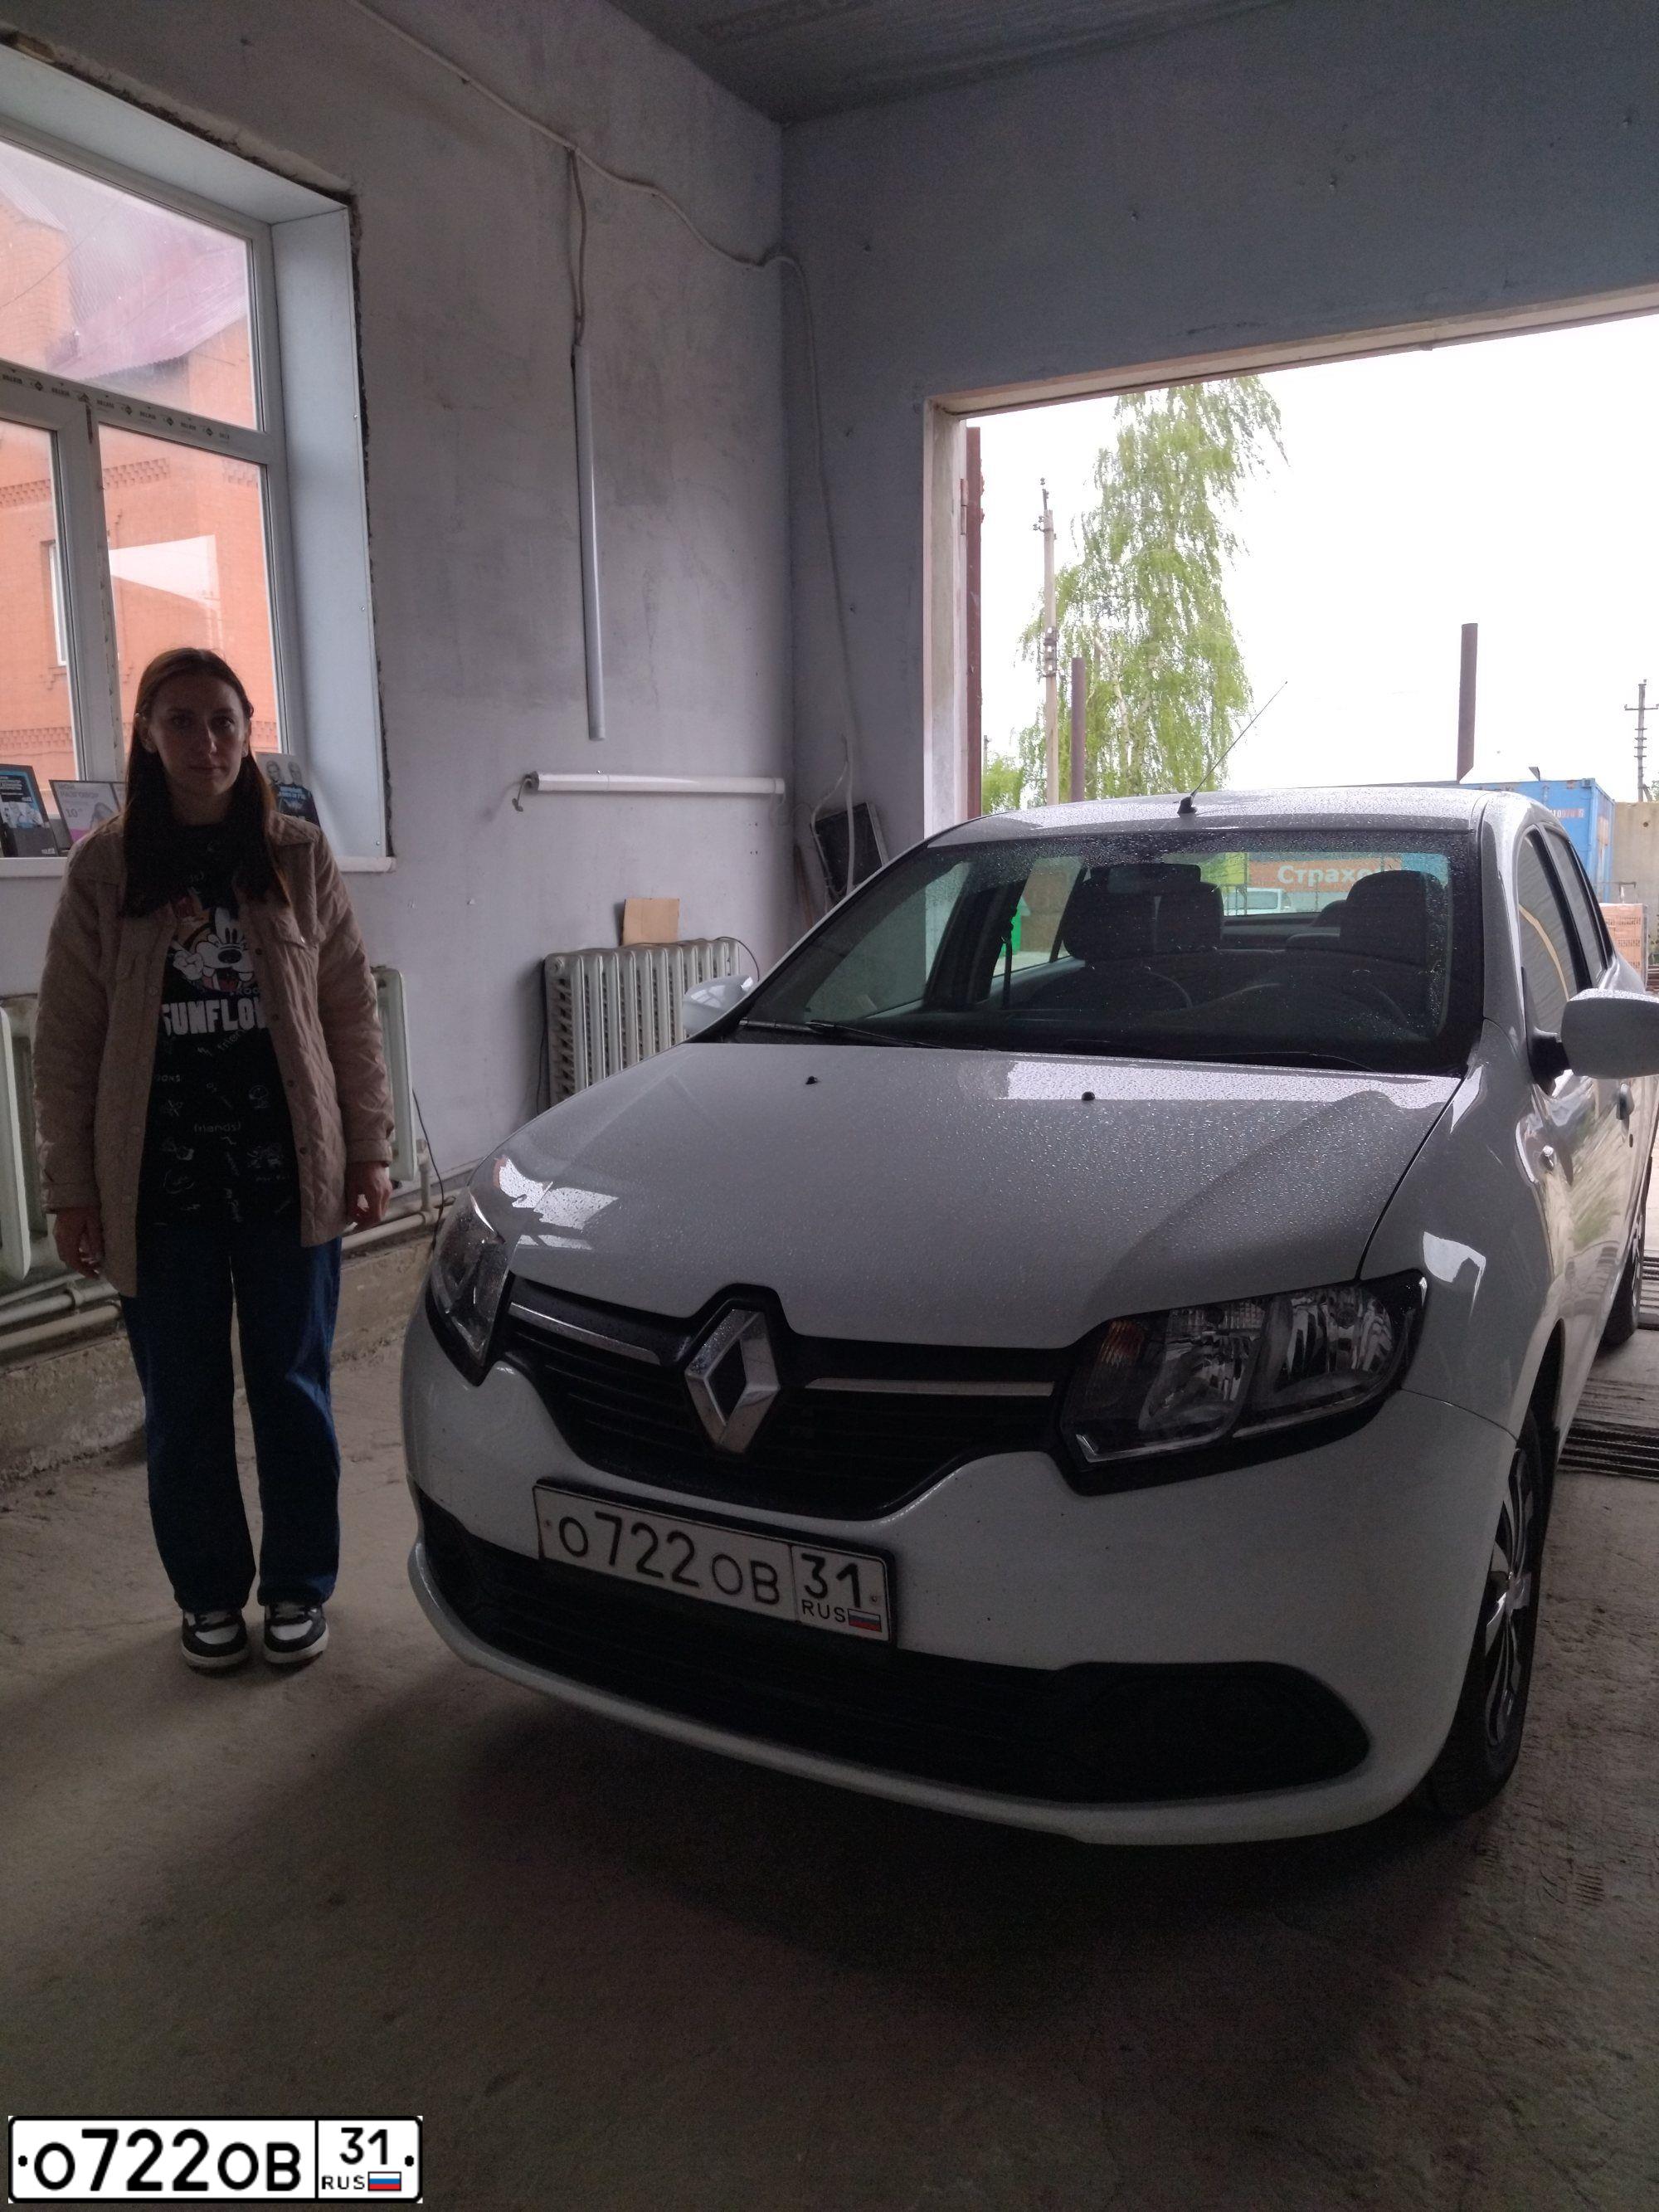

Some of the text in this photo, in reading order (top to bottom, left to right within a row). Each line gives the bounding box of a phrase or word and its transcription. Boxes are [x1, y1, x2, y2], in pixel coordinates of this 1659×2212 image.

[559, 1510, 861, 1608] О722ОВ 31
[802, 1600, 846, 1623] RUS
